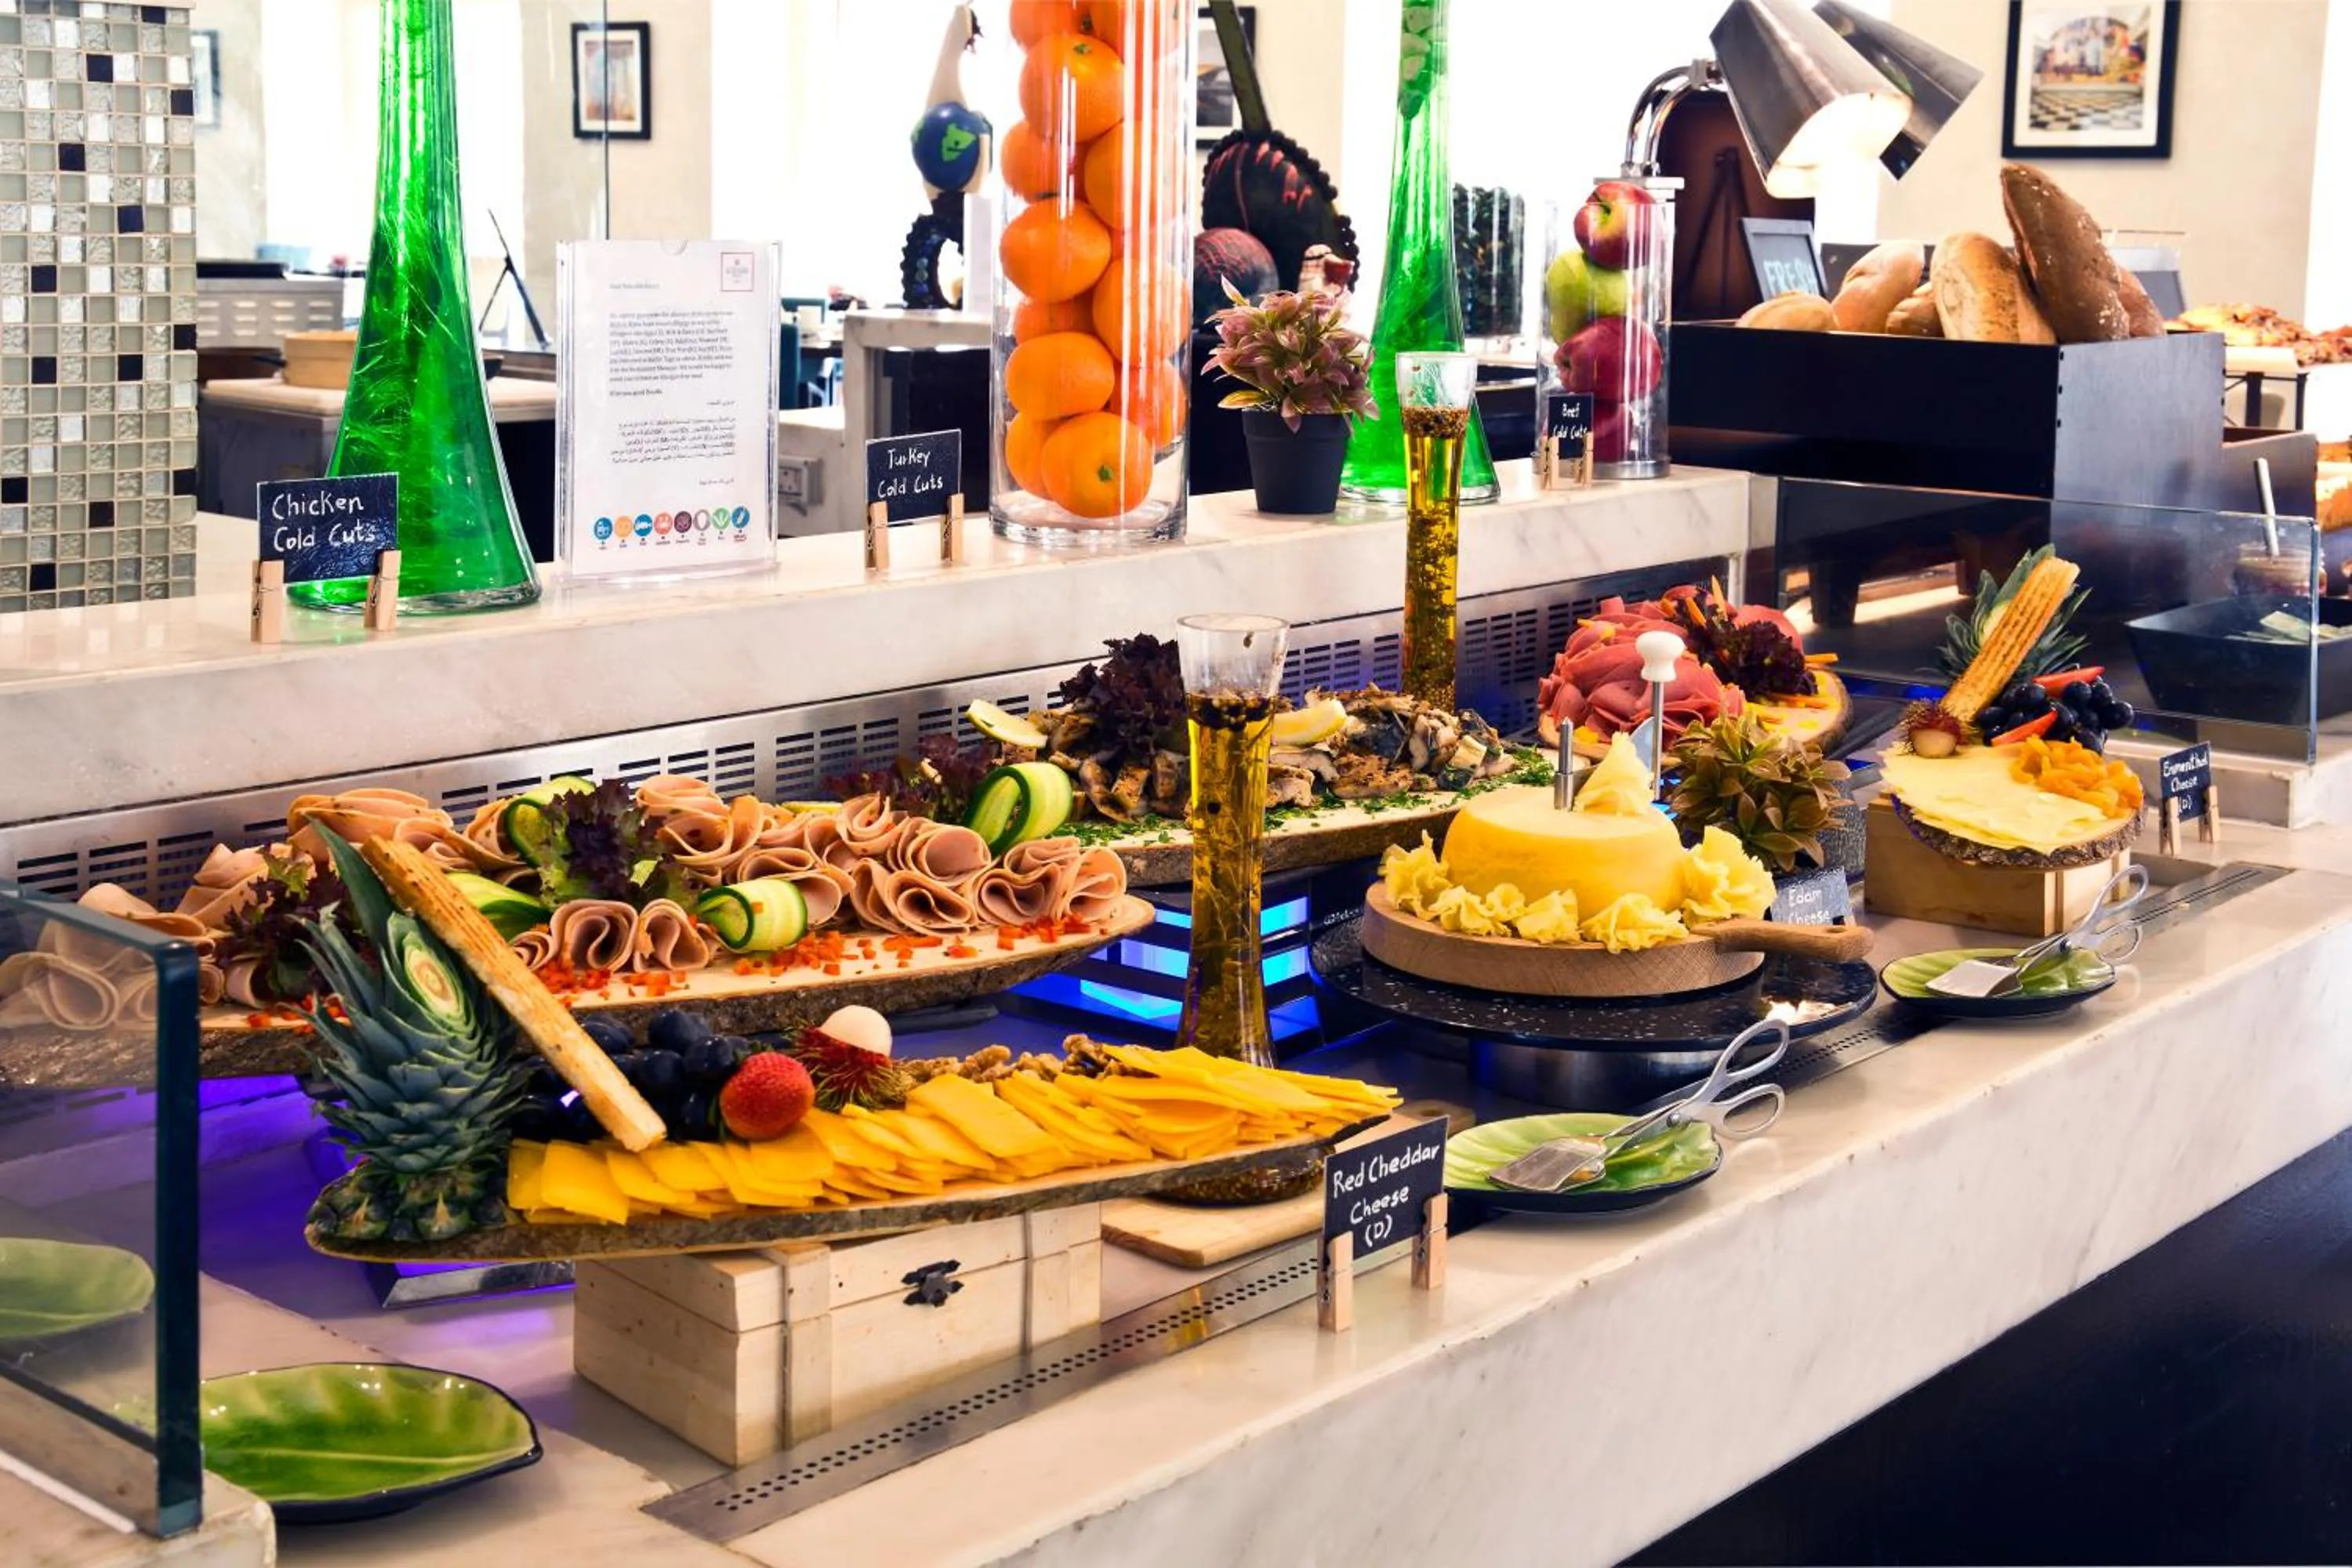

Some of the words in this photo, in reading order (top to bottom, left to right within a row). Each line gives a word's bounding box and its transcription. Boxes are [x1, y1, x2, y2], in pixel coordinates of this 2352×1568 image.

[877, 477, 907, 498] Cold
[914, 474, 943, 493] Cuts
[274, 526, 316, 552] Cold
[328, 518, 377, 546] Cuts
[1334, 1161, 1365, 1199] Red
[1368, 1142, 1440, 1183] Cheddar
[1349, 1185, 1410, 1225] Cheese
[1365, 1214, 1393, 1247] (D)
